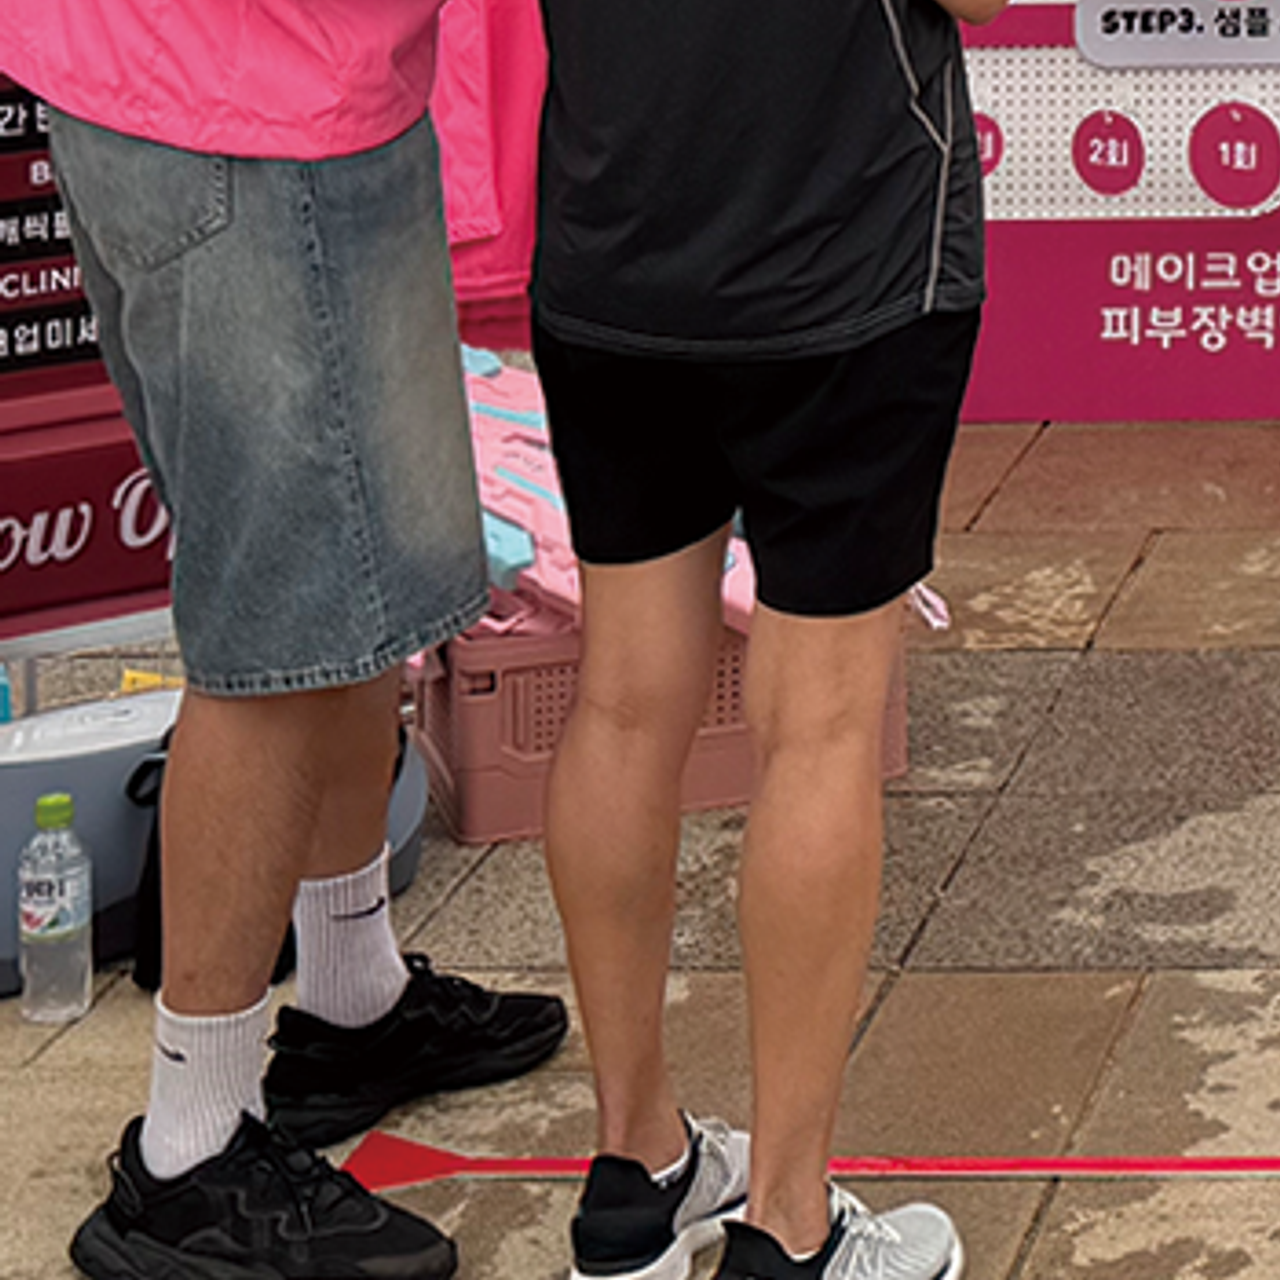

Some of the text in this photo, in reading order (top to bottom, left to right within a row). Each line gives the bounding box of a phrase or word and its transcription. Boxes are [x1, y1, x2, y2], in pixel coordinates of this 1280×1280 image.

[1101, 7, 1205, 35] STEP3.
[1213, 6, 1270, 38] 샘플
[1088, 137, 1129, 167] 2회
[1217, 140, 1257, 171] 1회
